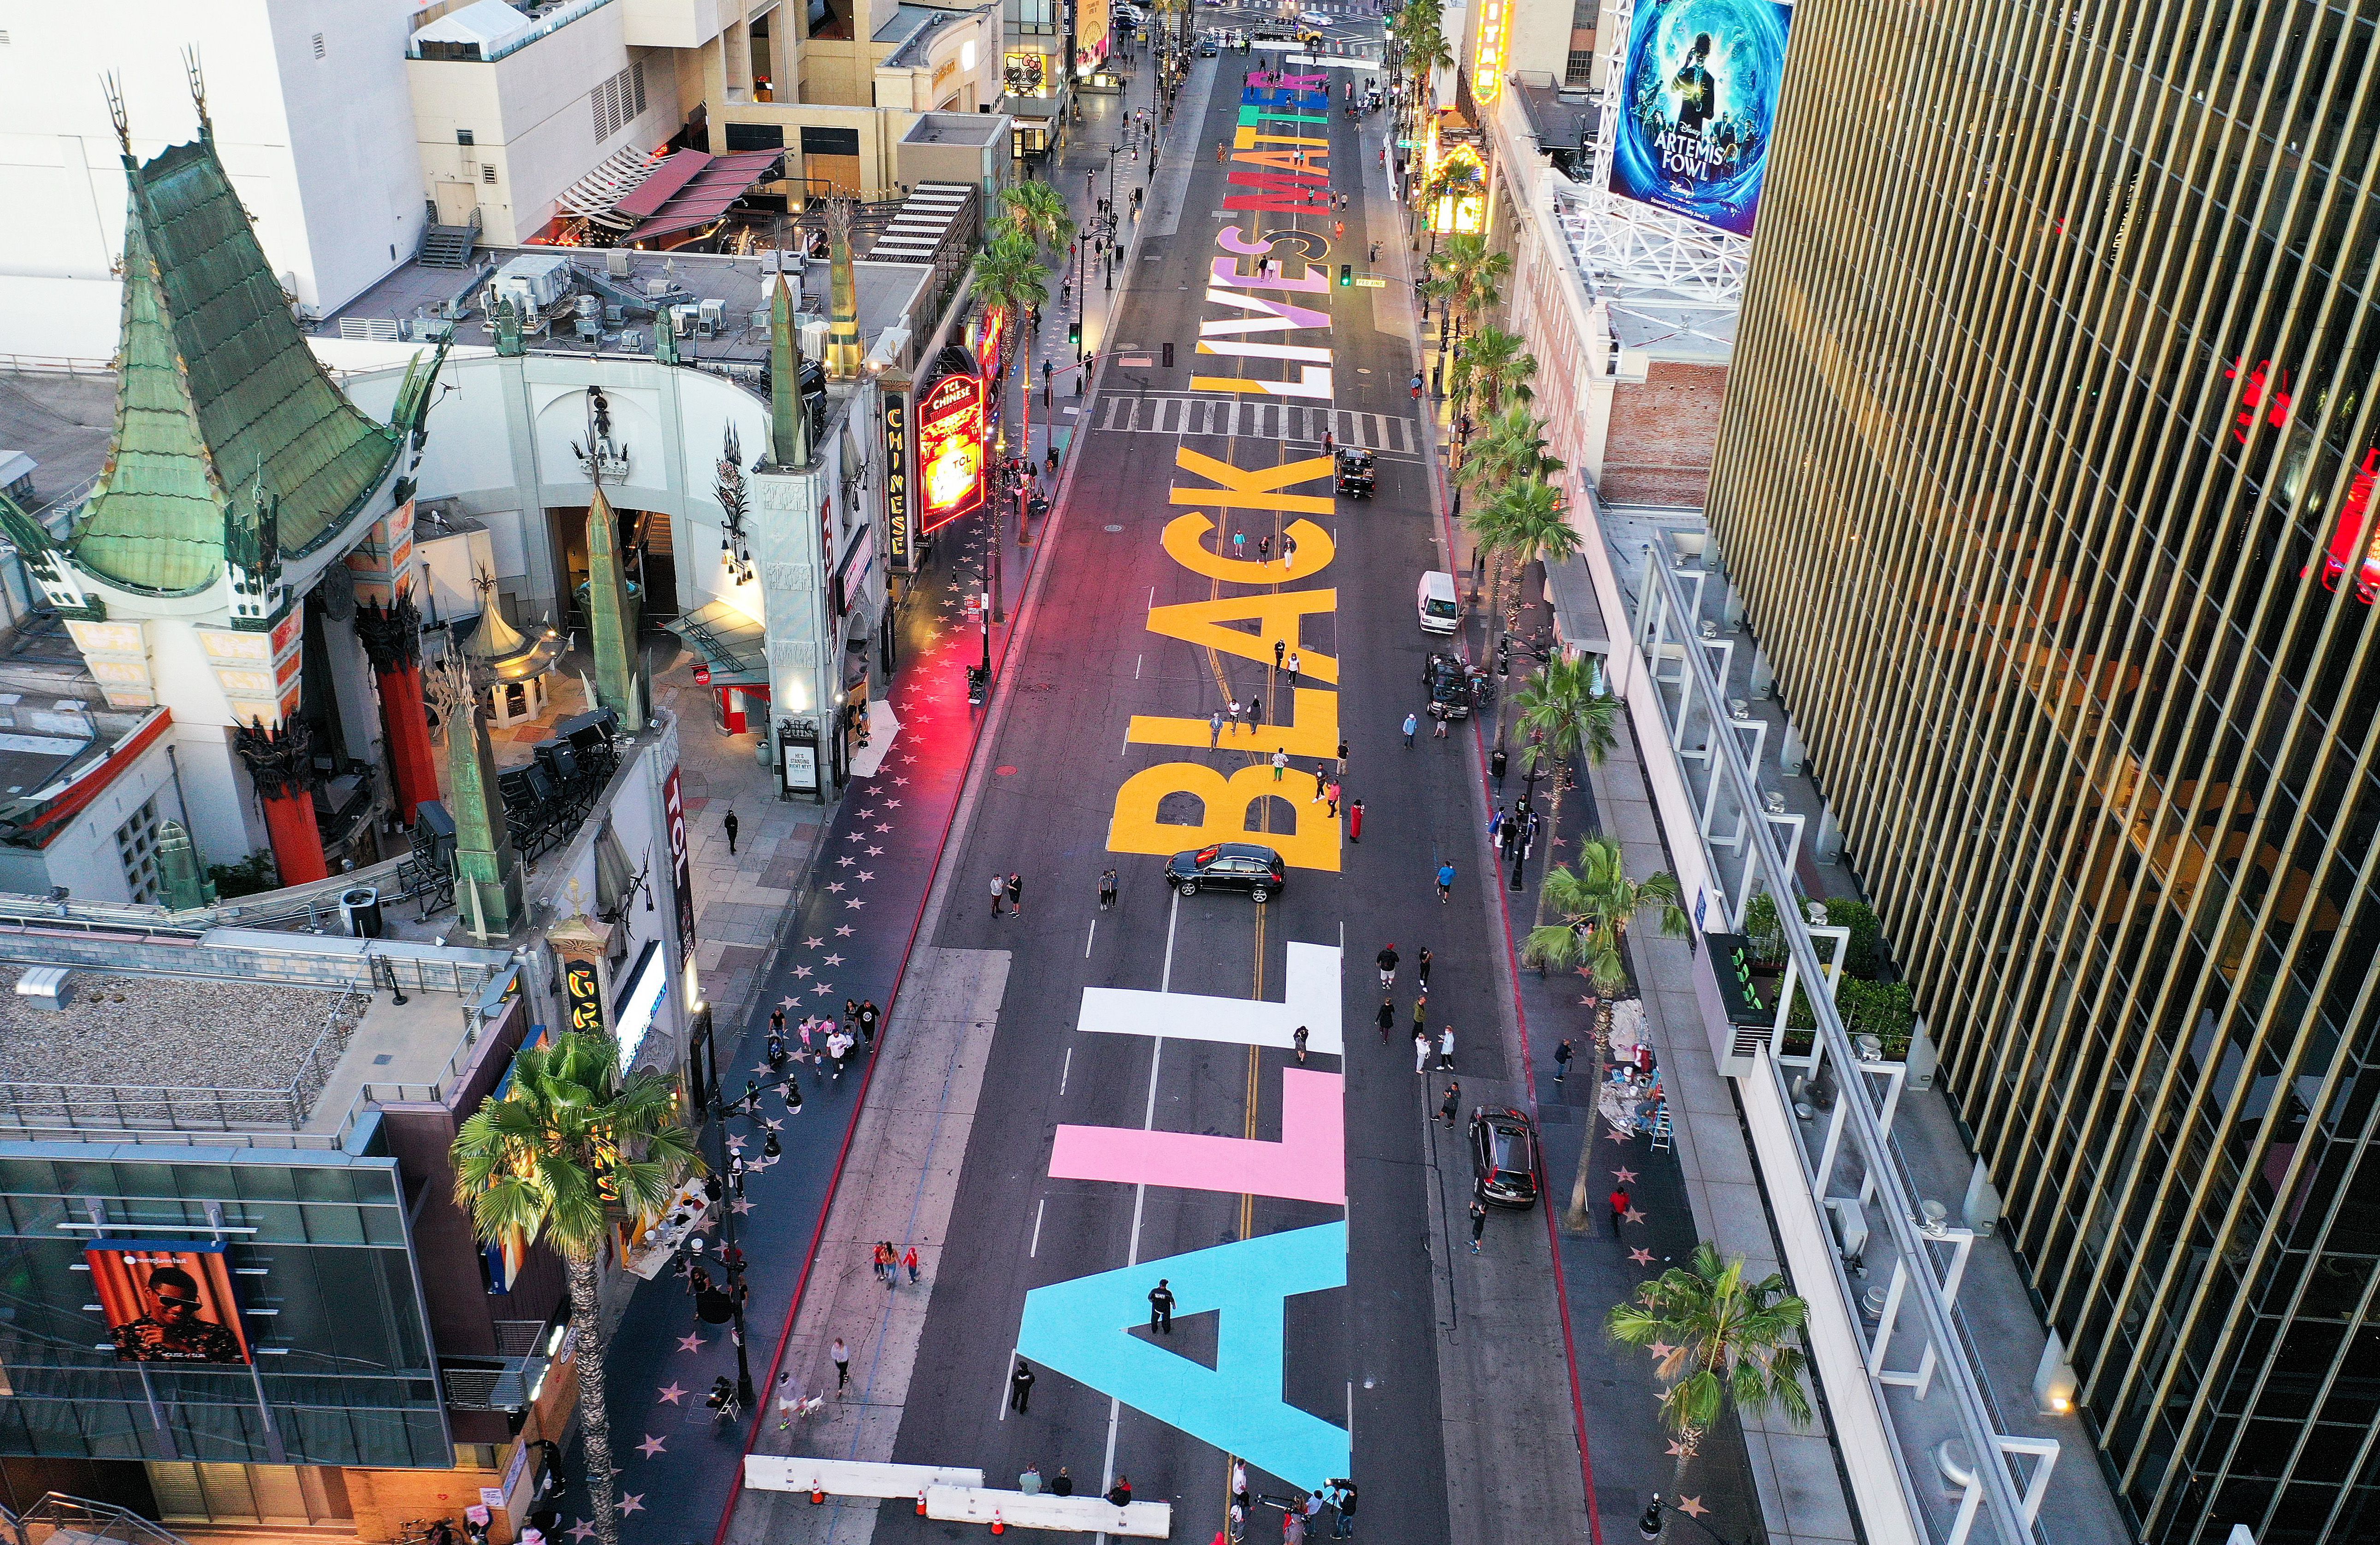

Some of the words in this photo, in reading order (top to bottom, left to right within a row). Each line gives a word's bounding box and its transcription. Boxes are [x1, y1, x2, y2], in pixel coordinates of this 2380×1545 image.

[1222, 70, 1331, 216] MATTER
[1653, 131, 1724, 166] ARTEMIS
[1662, 149, 1710, 182] FOWL
[1190, 225, 1333, 400] LIVES
[930, 395, 974, 422] THEATRES
[933, 386, 971, 410] CHINESE
[943, 380, 960, 394] TCL
[887, 408, 905, 555] CHINESE
[953, 454, 972, 469] TCL
[823, 506, 834, 595] TCL
[1107, 446, 1342, 872] BLACK
[668, 778, 686, 890] TCL
[1017, 941, 1350, 1510] ALL
